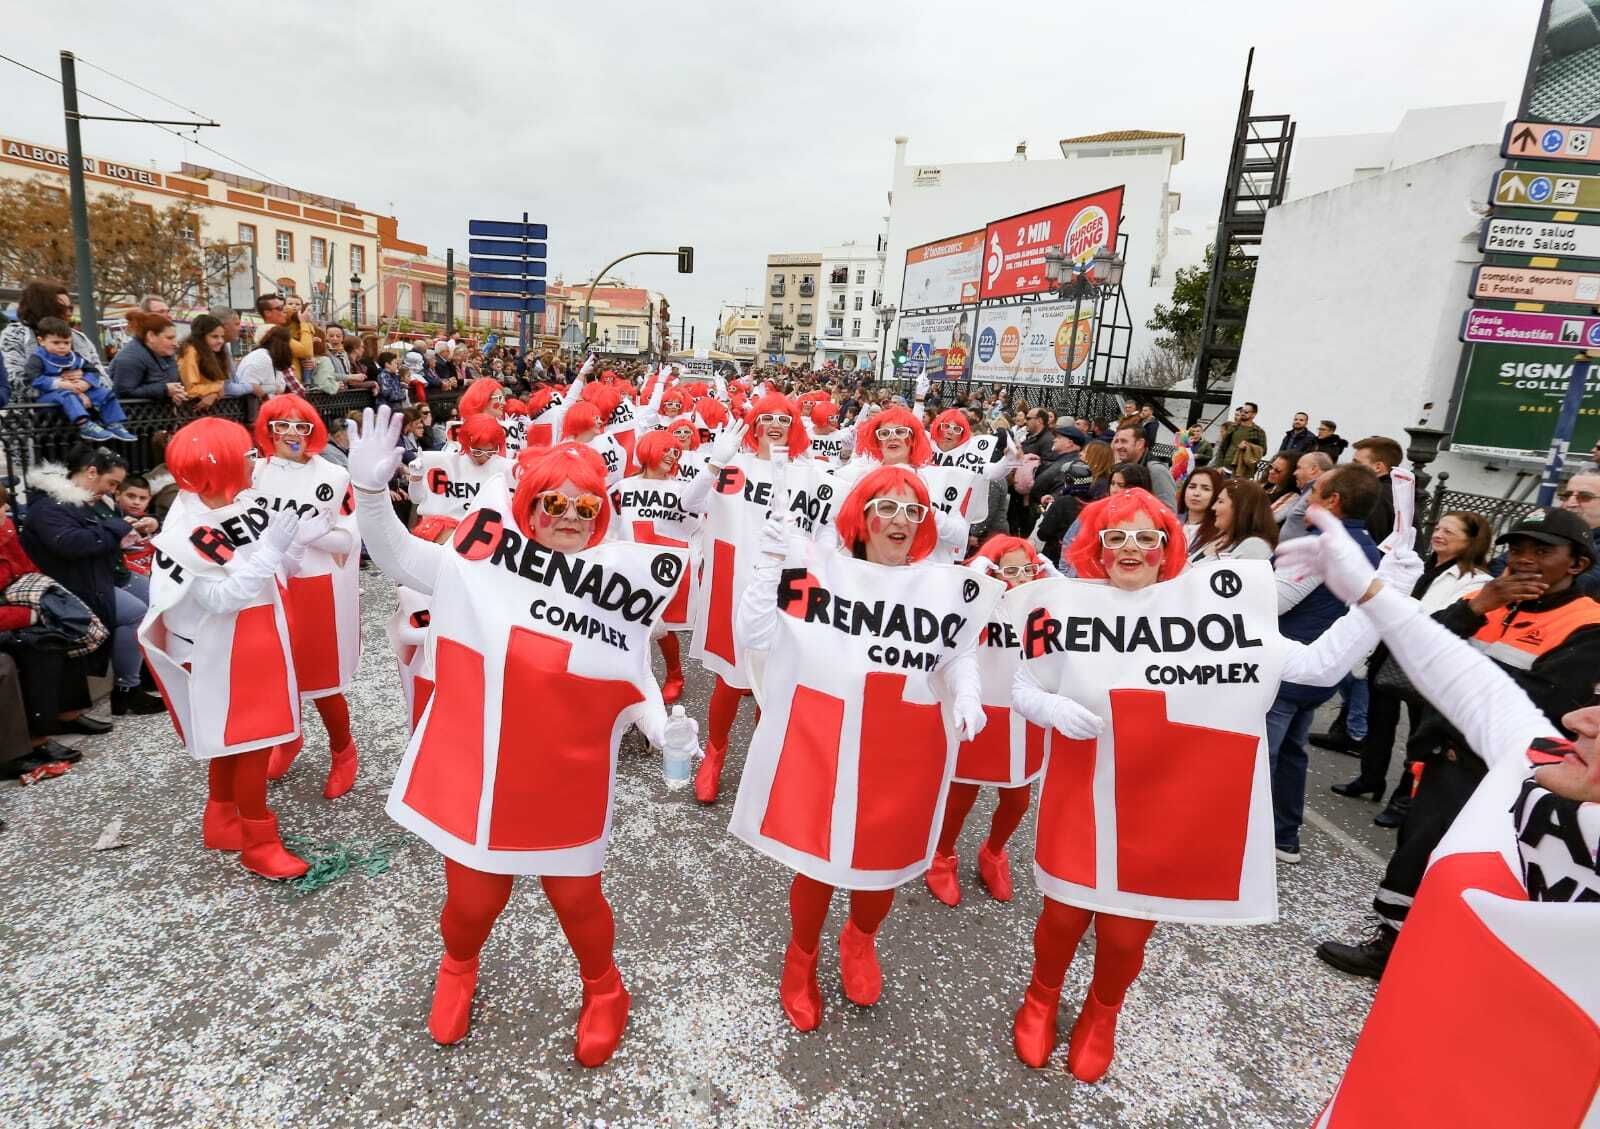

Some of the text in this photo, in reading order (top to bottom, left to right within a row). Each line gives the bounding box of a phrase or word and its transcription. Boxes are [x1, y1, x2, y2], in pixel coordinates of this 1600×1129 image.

[8, 142, 157, 184] ALBORN HOTEL
[1016, 220, 1051, 247] 2 MIN
[1070, 216, 1103, 245] BURGER
[1492, 224, 1575, 238] centro salud
[1071, 227, 1104, 259] KING
[1489, 236, 1576, 251] Padre Salado
[1481, 272, 1573, 286] complejo deportivo
[1478, 283, 1534, 295] El Fontanal
[1471, 315, 1503, 326] Iglesia
[1470, 326, 1554, 340] San Sebastián
[1043, 374, 1055, 385] 956
[638, 508, 687, 523] COMPLEX
[455, 507, 665, 628] FRENADOL
[530, 599, 629, 651] COMPLEX
[1025, 607, 1263, 660] FRENADOL
[1145, 662, 1260, 686] COMPLEX
